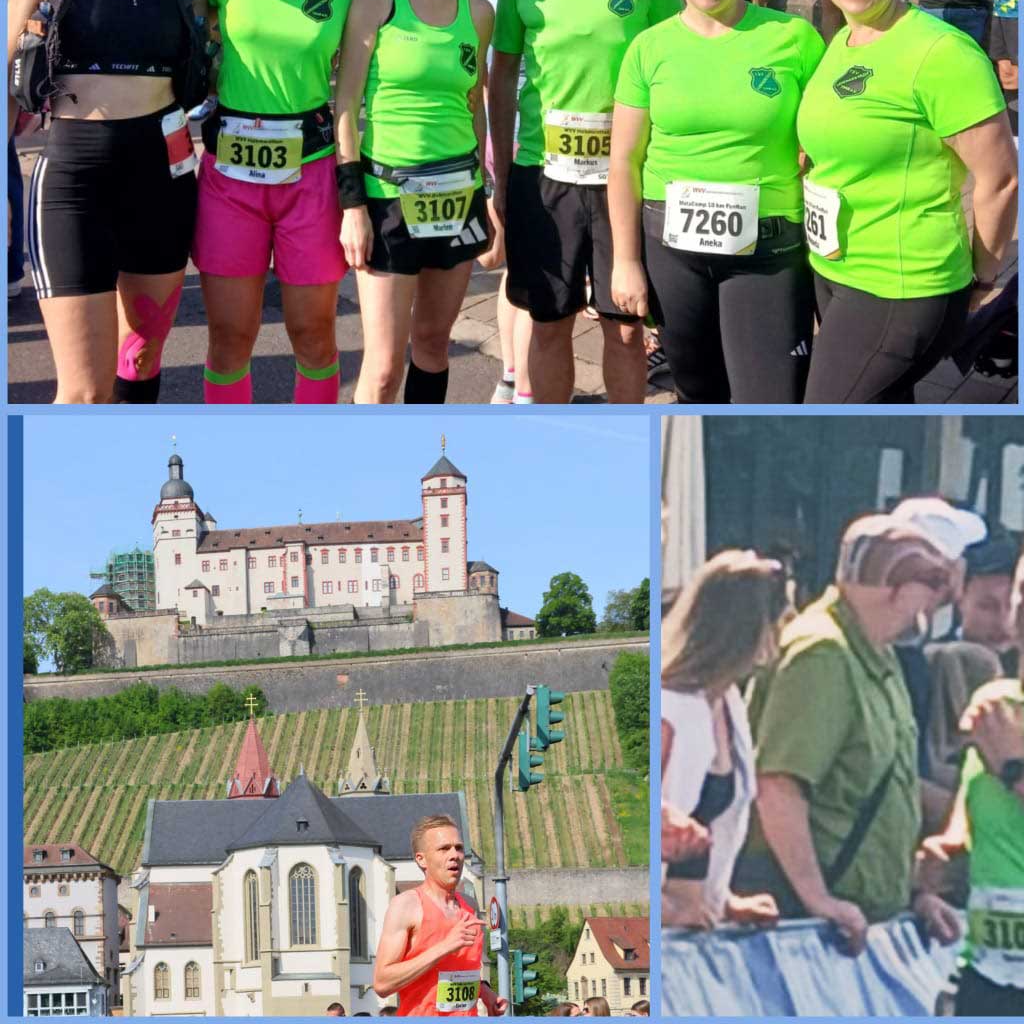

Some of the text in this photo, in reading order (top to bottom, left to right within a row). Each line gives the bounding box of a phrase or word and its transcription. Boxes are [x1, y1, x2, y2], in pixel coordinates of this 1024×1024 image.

[230, 142, 287, 168] 3103
[559, 133, 611, 156] 3105
[249, 170, 266, 178] Alina
[414, 196, 467, 222] 3107
[680, 208, 743, 237] 7260
[806, 207, 827, 240] 261
[699, 238, 723, 248] Aneka
[446, 986, 475, 1002] 3108
